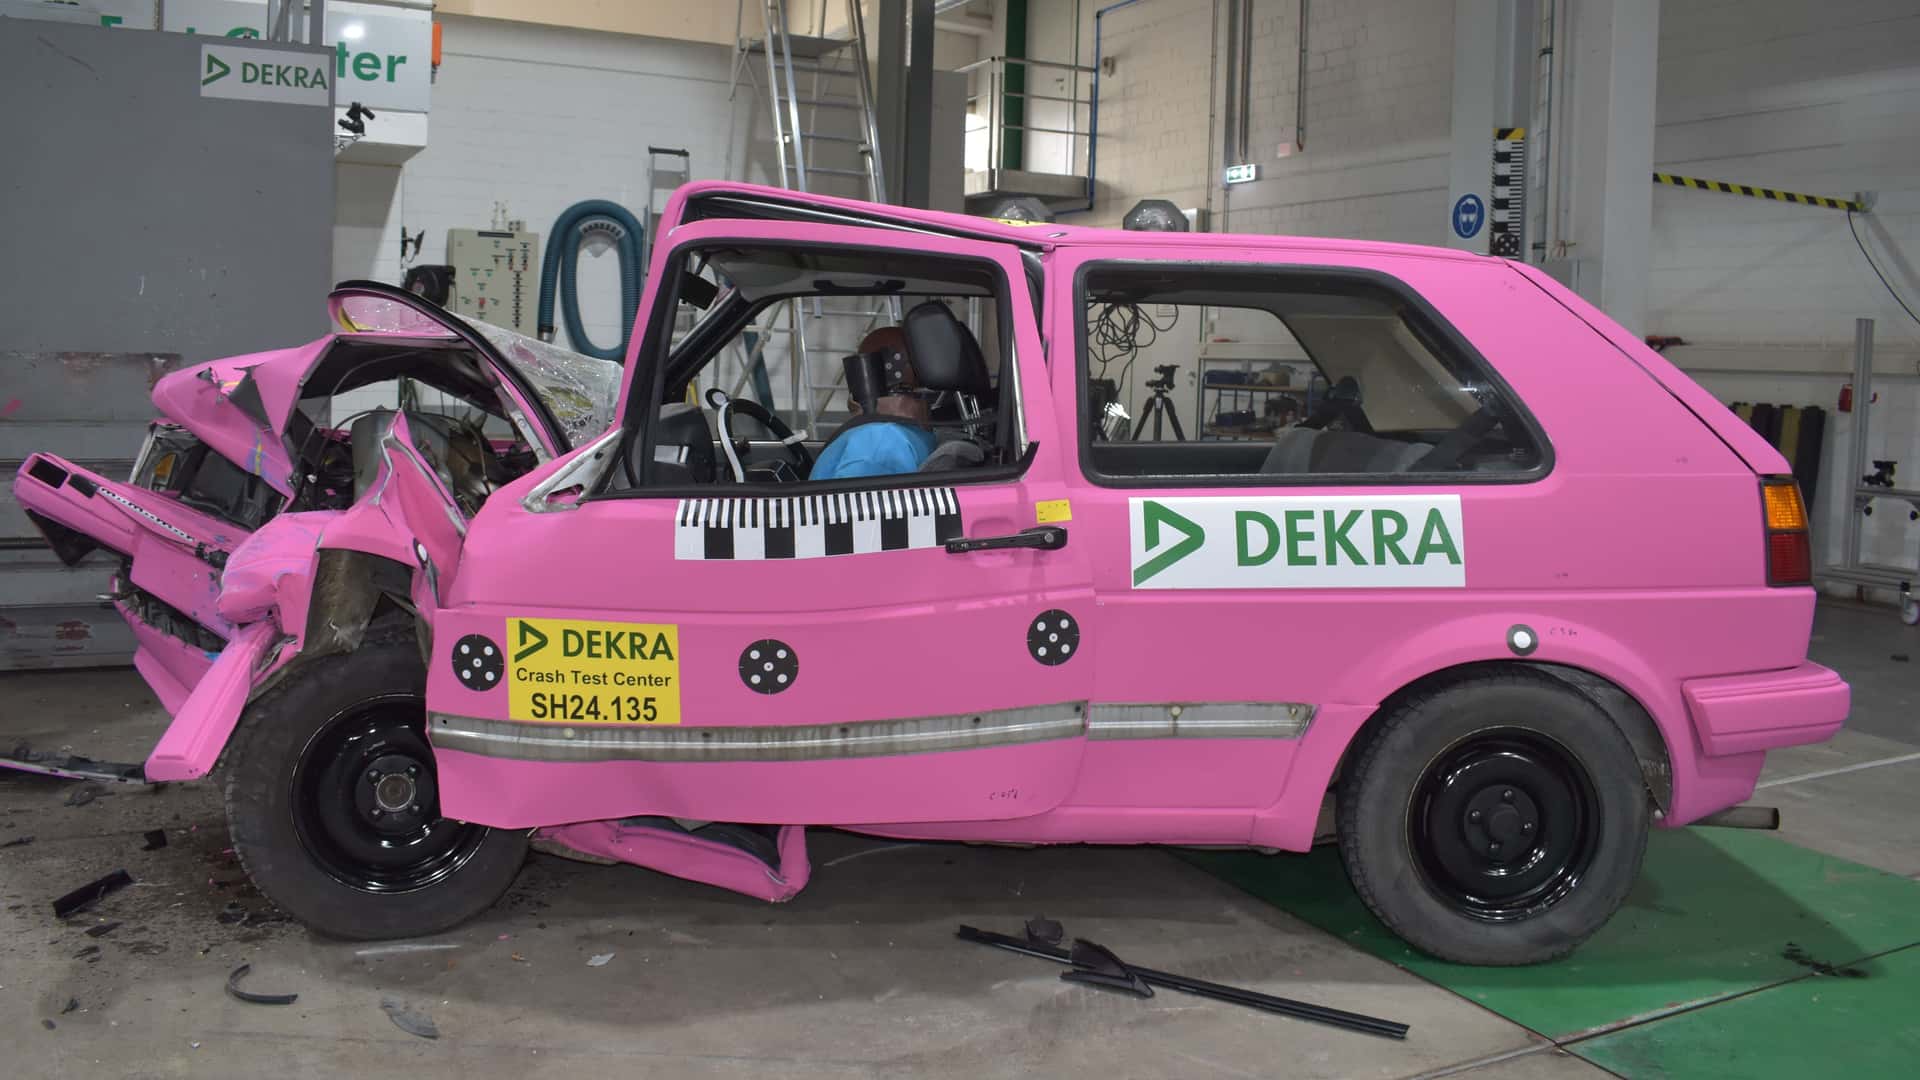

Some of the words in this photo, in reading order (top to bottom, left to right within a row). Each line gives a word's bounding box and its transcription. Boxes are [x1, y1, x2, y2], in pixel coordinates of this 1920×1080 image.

[242, 62, 328, 89] DEKRA
[336, 41, 407, 82] ter
[1235, 508, 1462, 566] DEKRA
[562, 629, 674, 660] DEKRA
[516, 667, 565, 683] Crash
[571, 670, 608, 686] Test
[613, 672, 671, 687] Center
[531, 693, 657, 721] SH24.135
